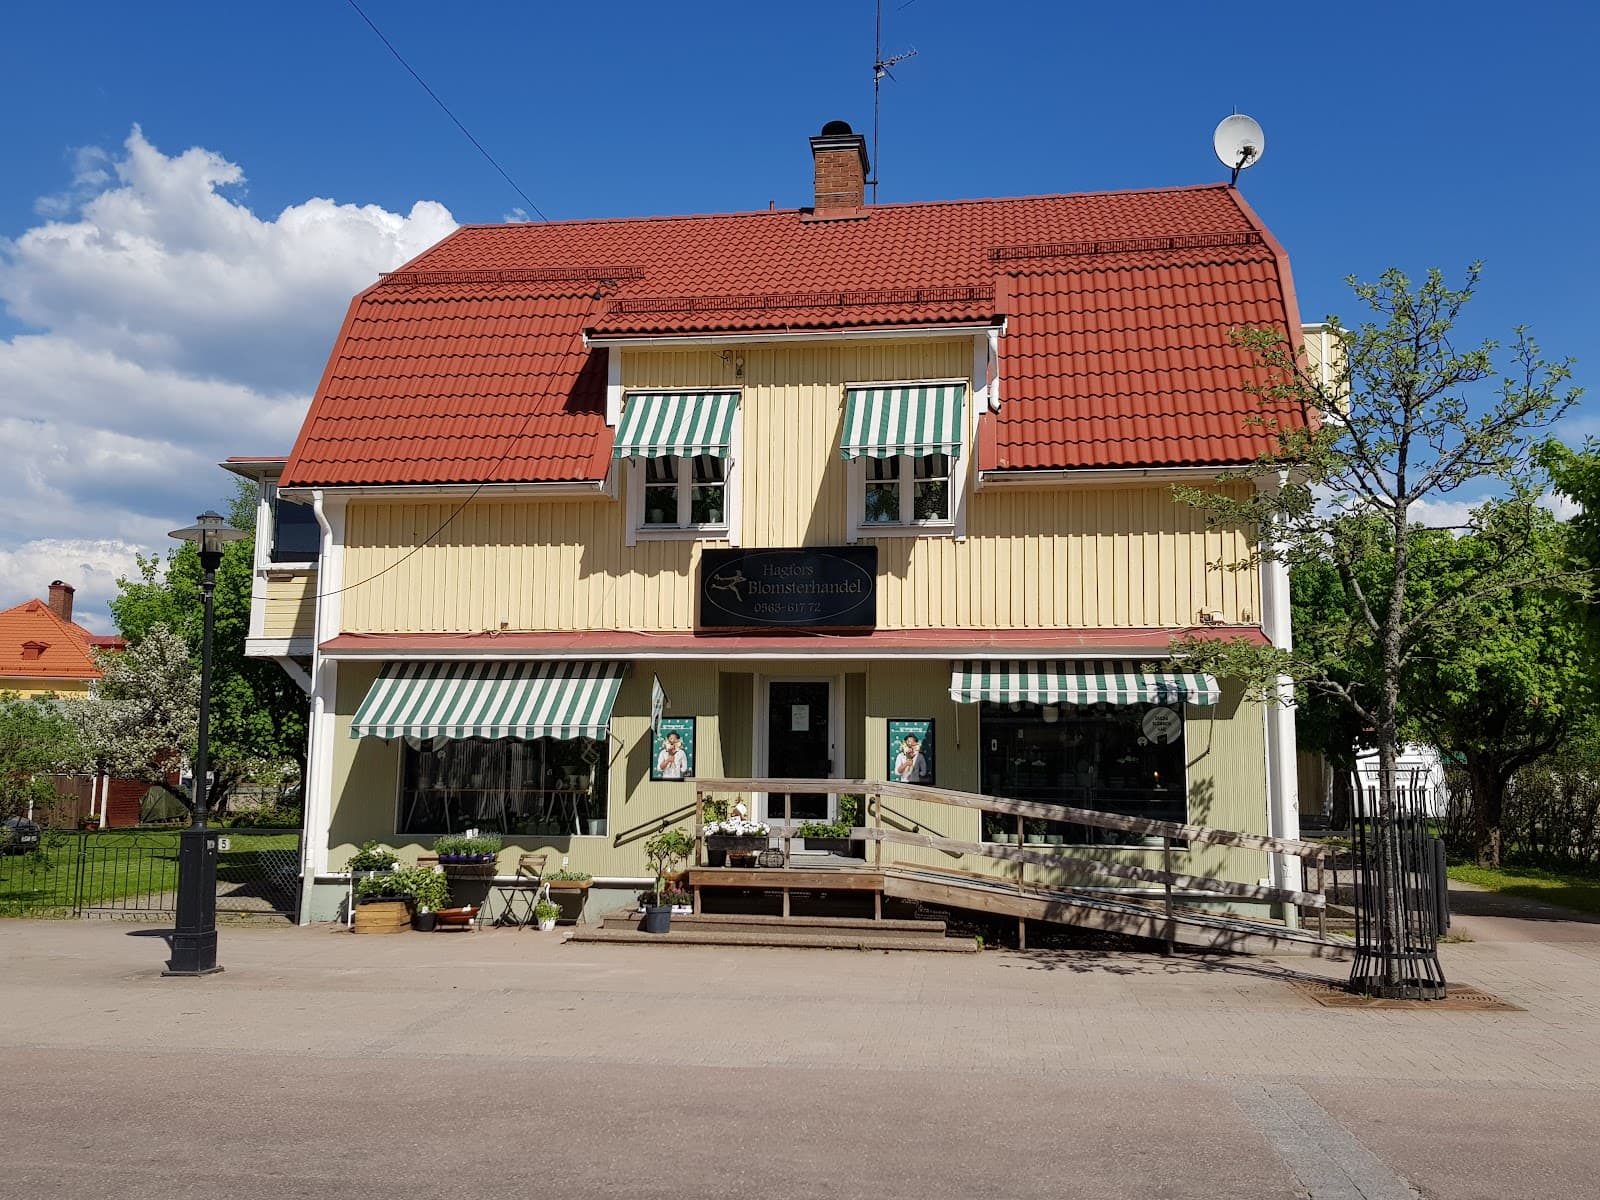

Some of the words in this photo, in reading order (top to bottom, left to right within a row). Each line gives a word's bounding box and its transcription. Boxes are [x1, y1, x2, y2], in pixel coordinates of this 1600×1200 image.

[763, 563, 814, 579] Hagfors
[748, 579, 862, 594] Blomsterhandel
[221, 839, 227, 849] 5
